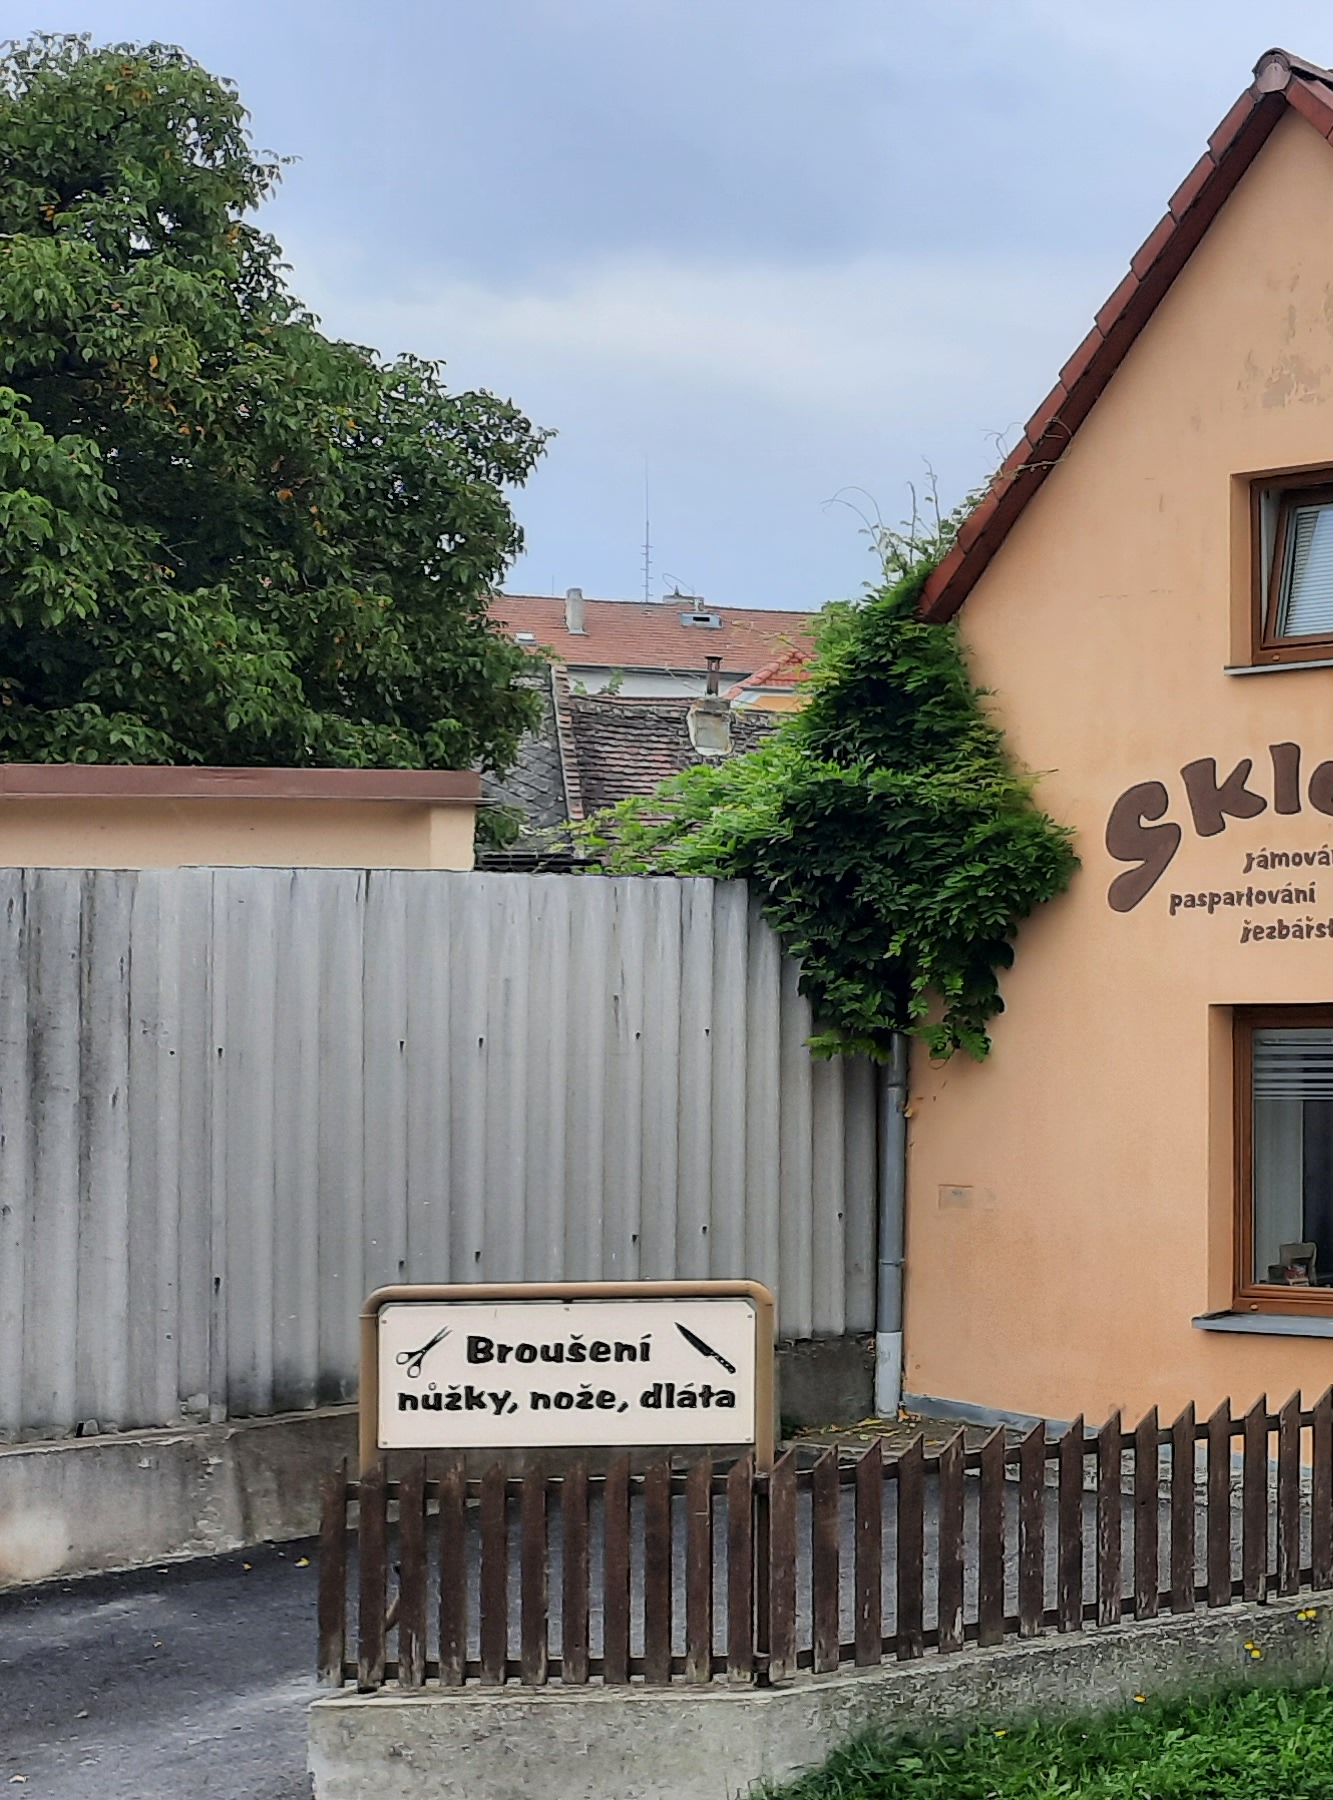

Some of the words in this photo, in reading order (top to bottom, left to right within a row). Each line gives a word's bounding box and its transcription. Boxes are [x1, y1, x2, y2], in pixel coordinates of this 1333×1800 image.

[1169, 882, 1316, 916] paspartování
[466, 1334, 653, 1364] Broušení
[397, 1382, 518, 1416] nůžky,
[529, 1383, 629, 1413] nože,
[640, 1382, 737, 1409] dláta
